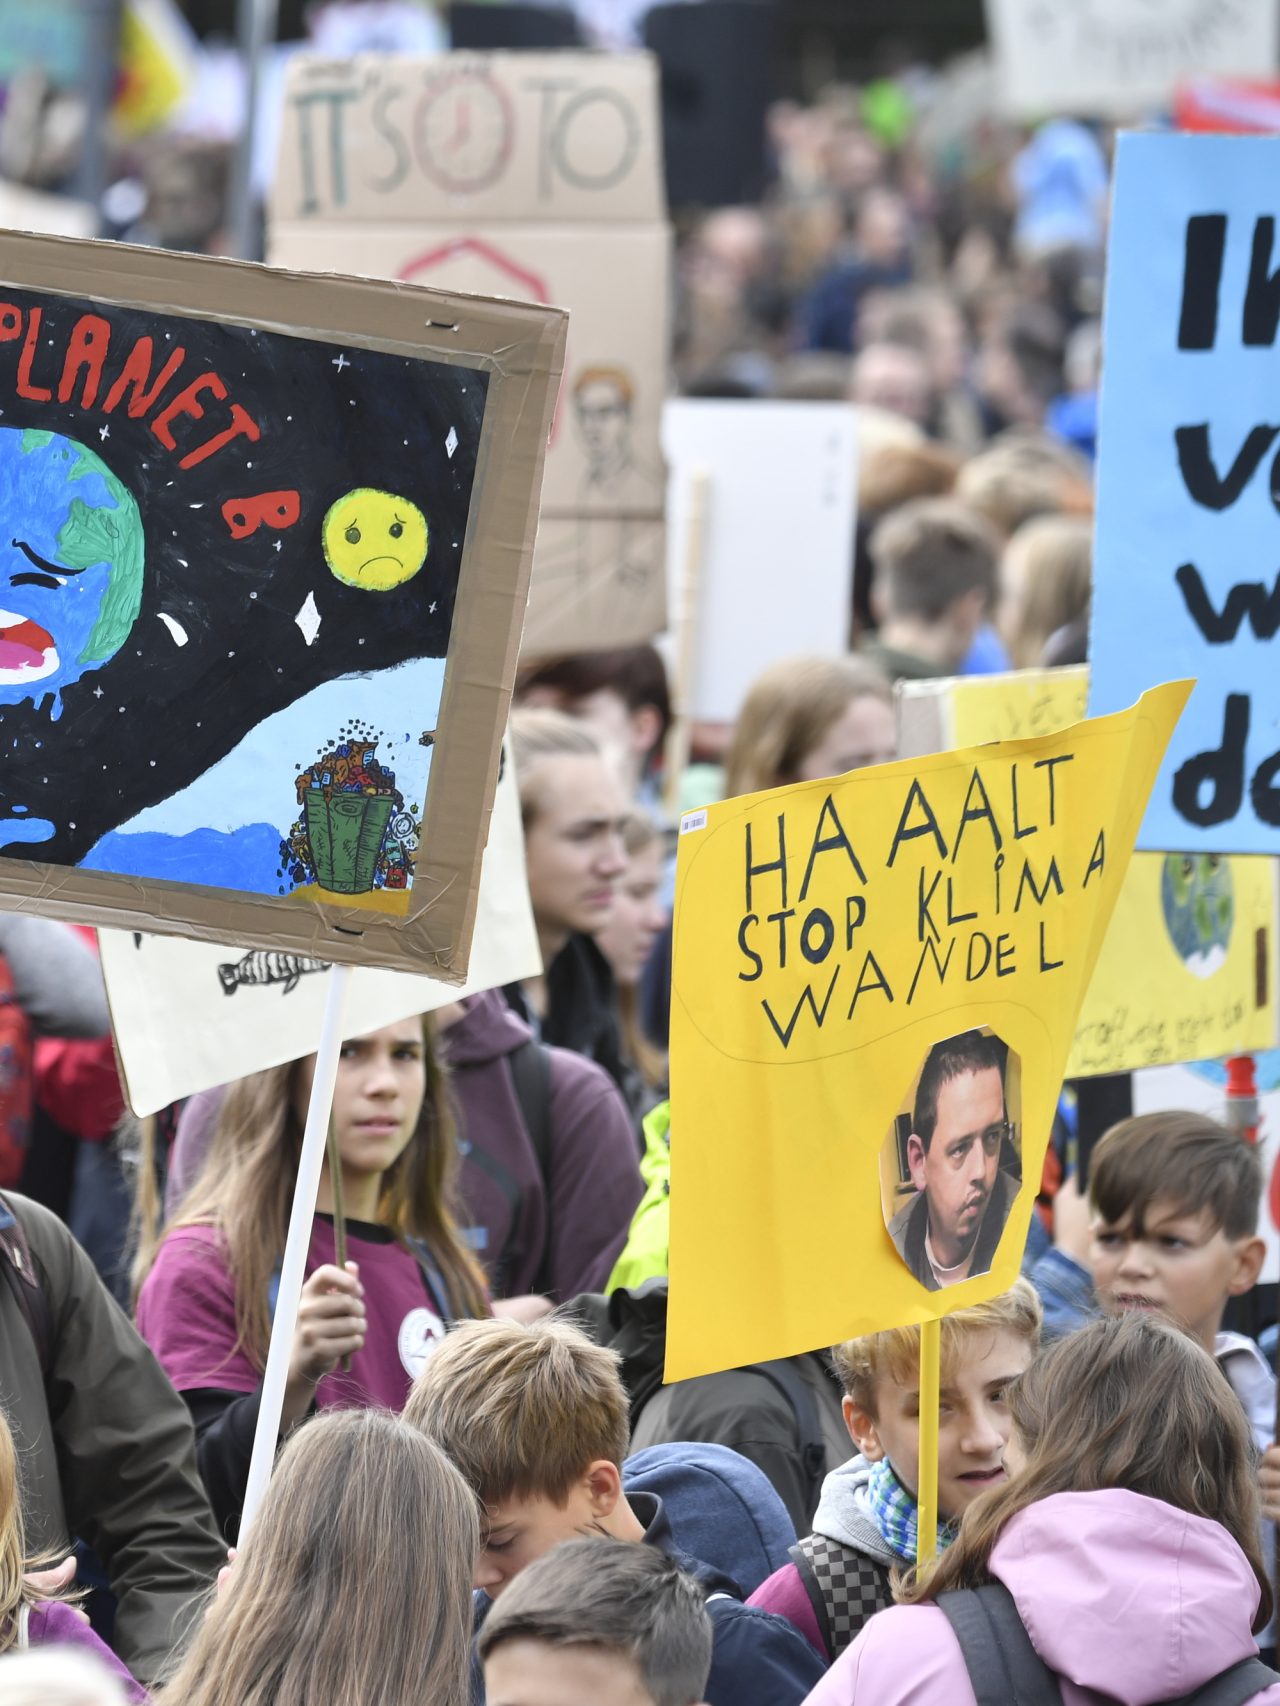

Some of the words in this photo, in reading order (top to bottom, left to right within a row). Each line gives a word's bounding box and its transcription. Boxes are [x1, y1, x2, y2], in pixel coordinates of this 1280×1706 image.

[522, 76, 643, 204] TO
[222, 490, 300, 538] B
[737, 895, 866, 982] STOP
[760, 922, 1064, 1050] WANDEL
